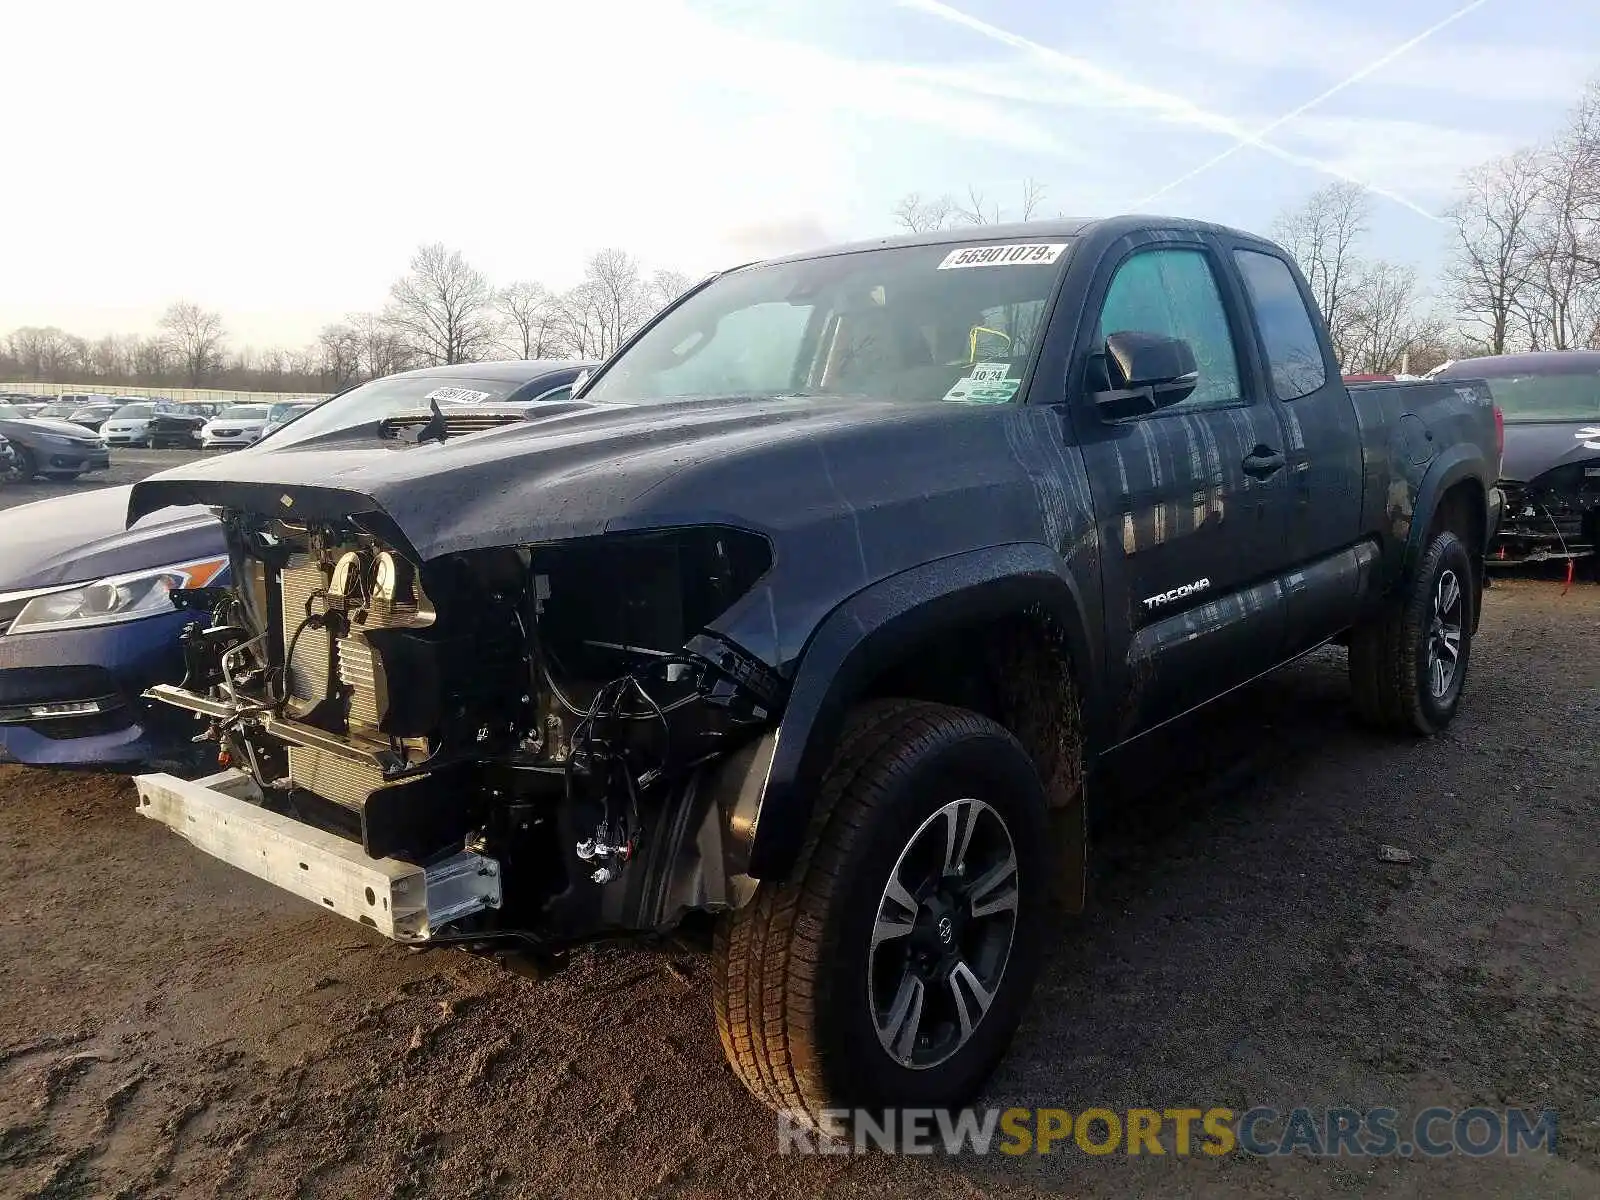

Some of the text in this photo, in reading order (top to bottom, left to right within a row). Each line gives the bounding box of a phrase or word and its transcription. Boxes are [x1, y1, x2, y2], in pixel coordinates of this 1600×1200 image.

[973, 370, 1003, 381] 10 24
[1142, 577, 1210, 610] TACOMA
